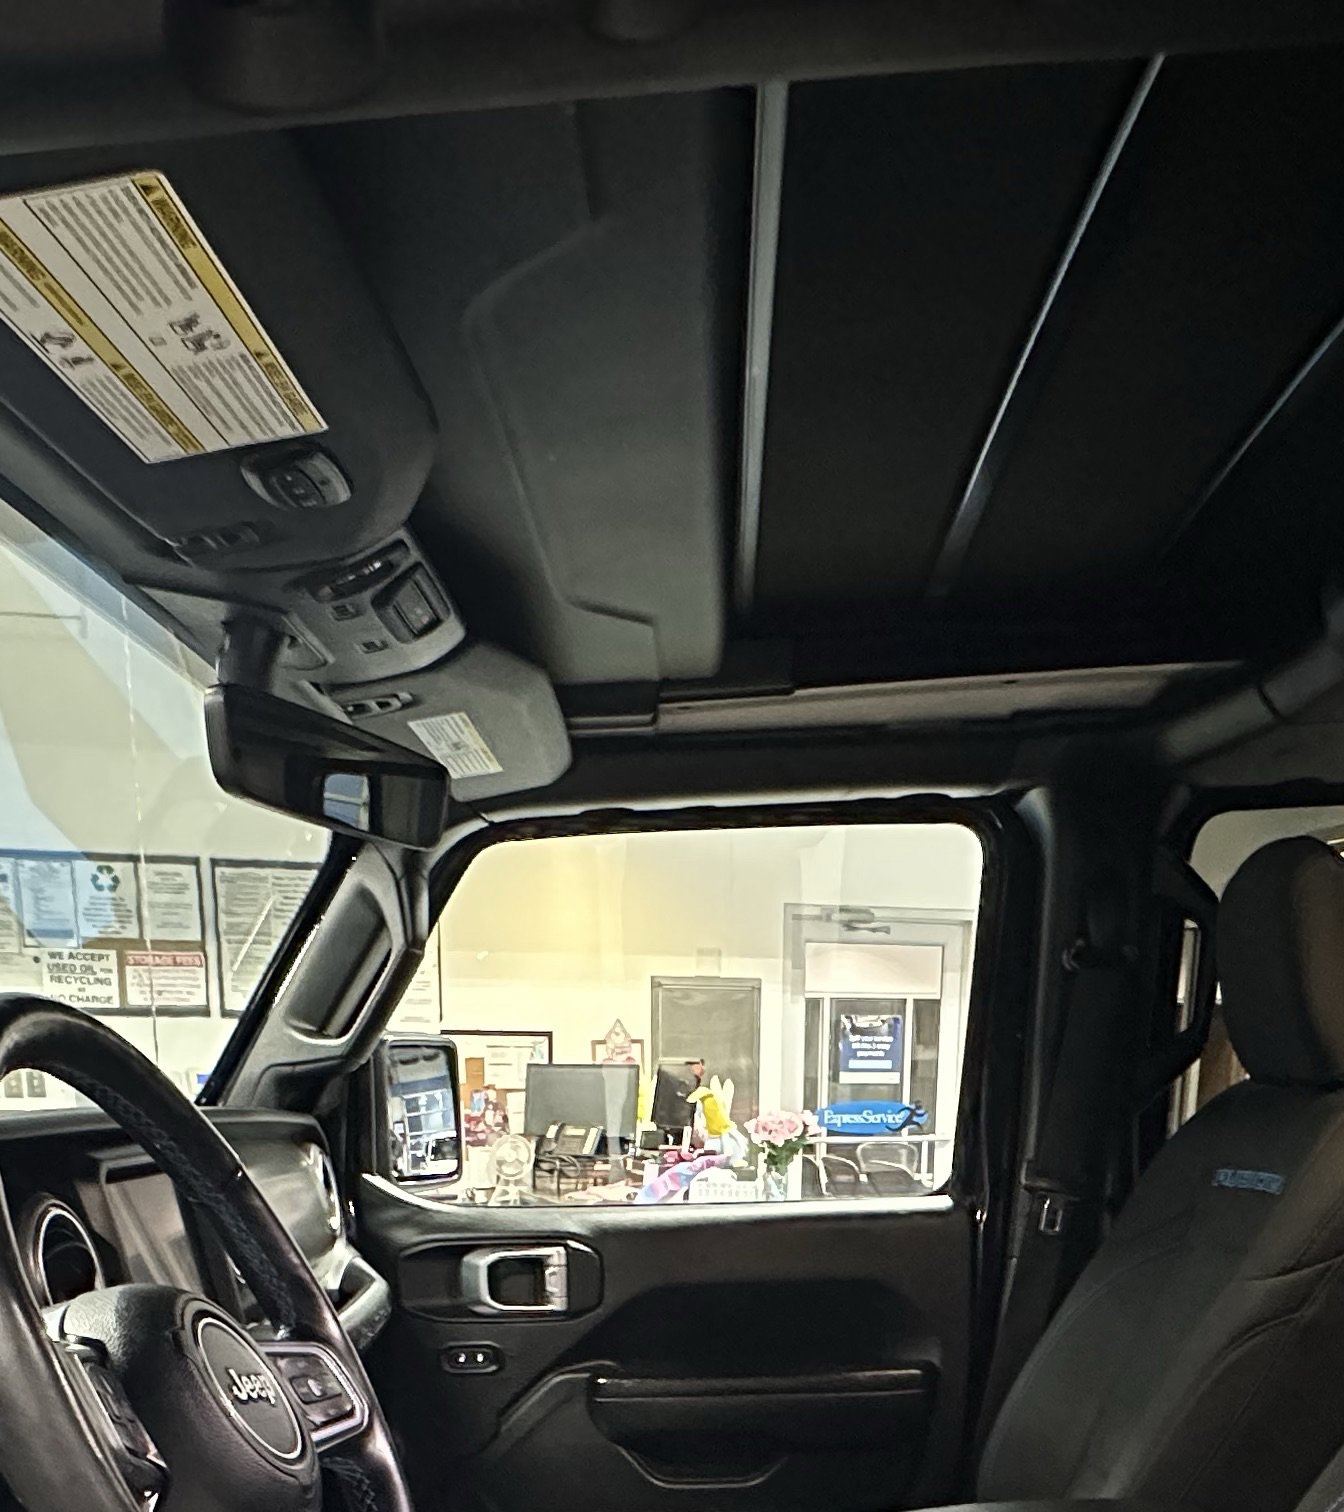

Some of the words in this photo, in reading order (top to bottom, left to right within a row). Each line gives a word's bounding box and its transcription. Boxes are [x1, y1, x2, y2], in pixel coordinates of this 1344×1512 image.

[47, 951, 65, 960] WE
[67, 952, 111, 962] ACCEPT
[47, 963, 77, 973] USED
[80, 964, 97, 974] OIL
[49, 975, 112, 986] RECYCLING
[68, 994, 113, 1004] CHARGE
[226, 1368, 276, 1406] Jeep
